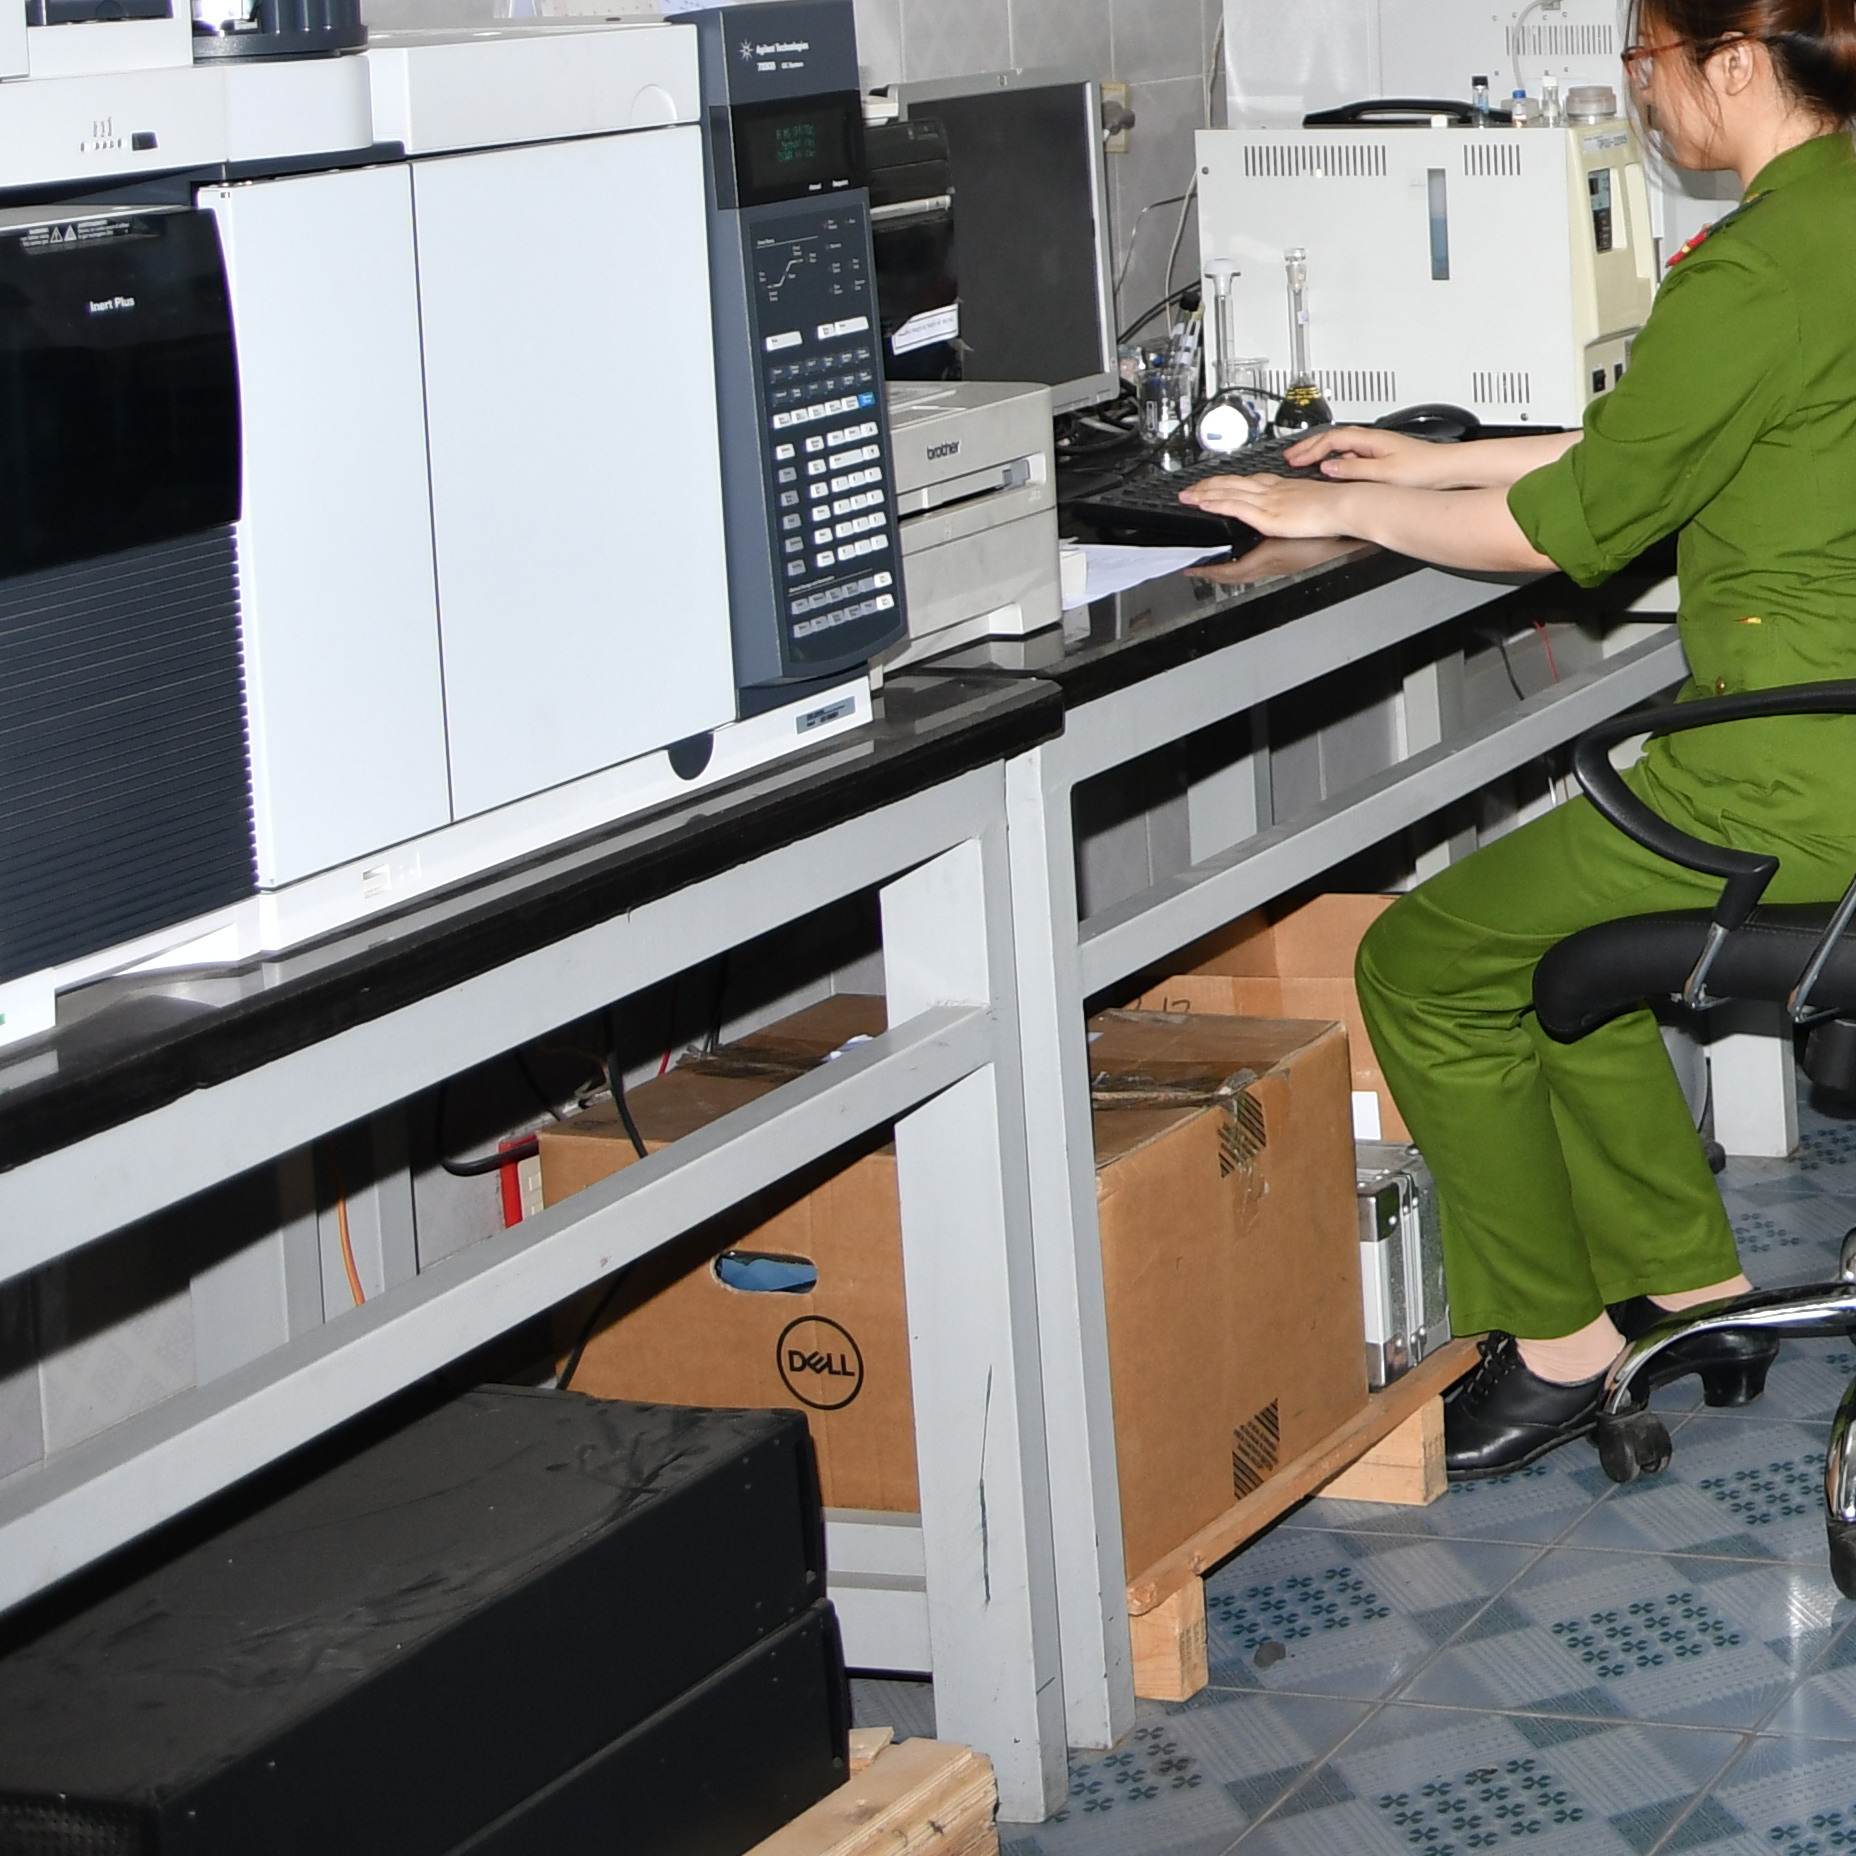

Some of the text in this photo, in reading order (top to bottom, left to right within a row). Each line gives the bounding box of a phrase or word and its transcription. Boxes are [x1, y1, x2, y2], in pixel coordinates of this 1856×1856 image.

[89, 296, 135, 312] Inert Plus
[927, 440, 960, 460] brother
[788, 1349, 856, 1377] DELL
